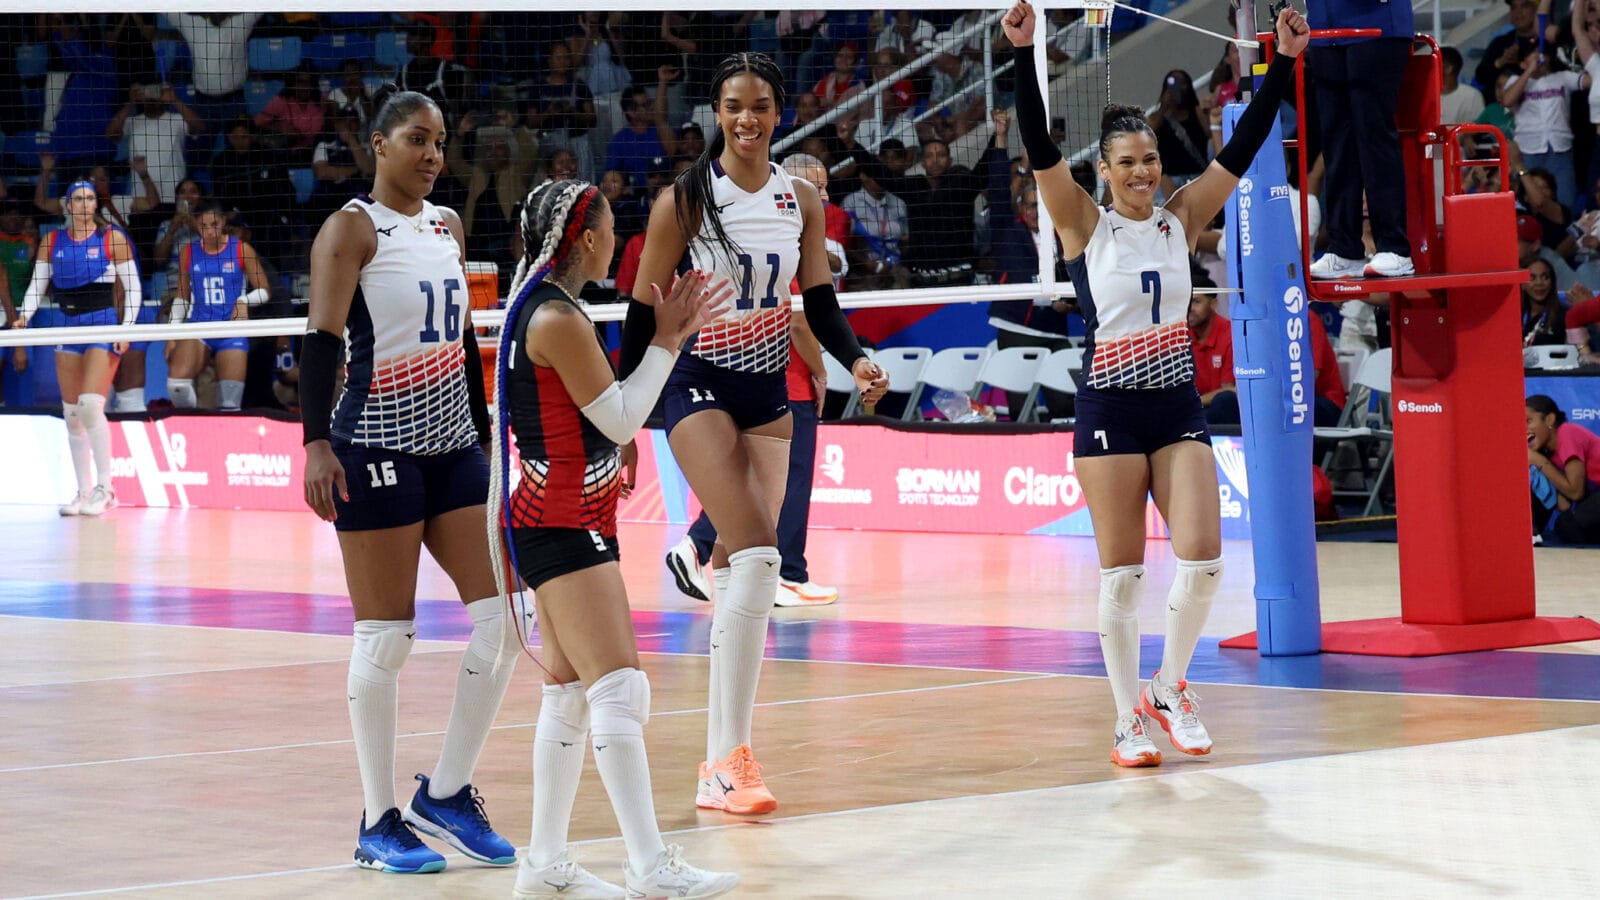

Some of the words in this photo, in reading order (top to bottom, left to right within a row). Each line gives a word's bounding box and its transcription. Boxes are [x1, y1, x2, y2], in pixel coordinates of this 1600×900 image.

[1239, 195, 1254, 256] Senoh
[203, 276, 225, 306] 16
[736, 253, 780, 310] 11
[418, 278, 461, 343] 16
[1140, 270, 1162, 325] 7
[1239, 367, 1266, 376] Senoh
[1286, 317, 1308, 424] Senoh
[689, 388, 716, 403] 11
[1407, 402, 1442, 413] Senoh
[1093, 430, 1109, 450] 7
[366, 460, 398, 488] 16
[898, 468, 980, 493] BORNAN
[1003, 466, 1081, 506] Claro
[588, 530, 608, 552] 5
